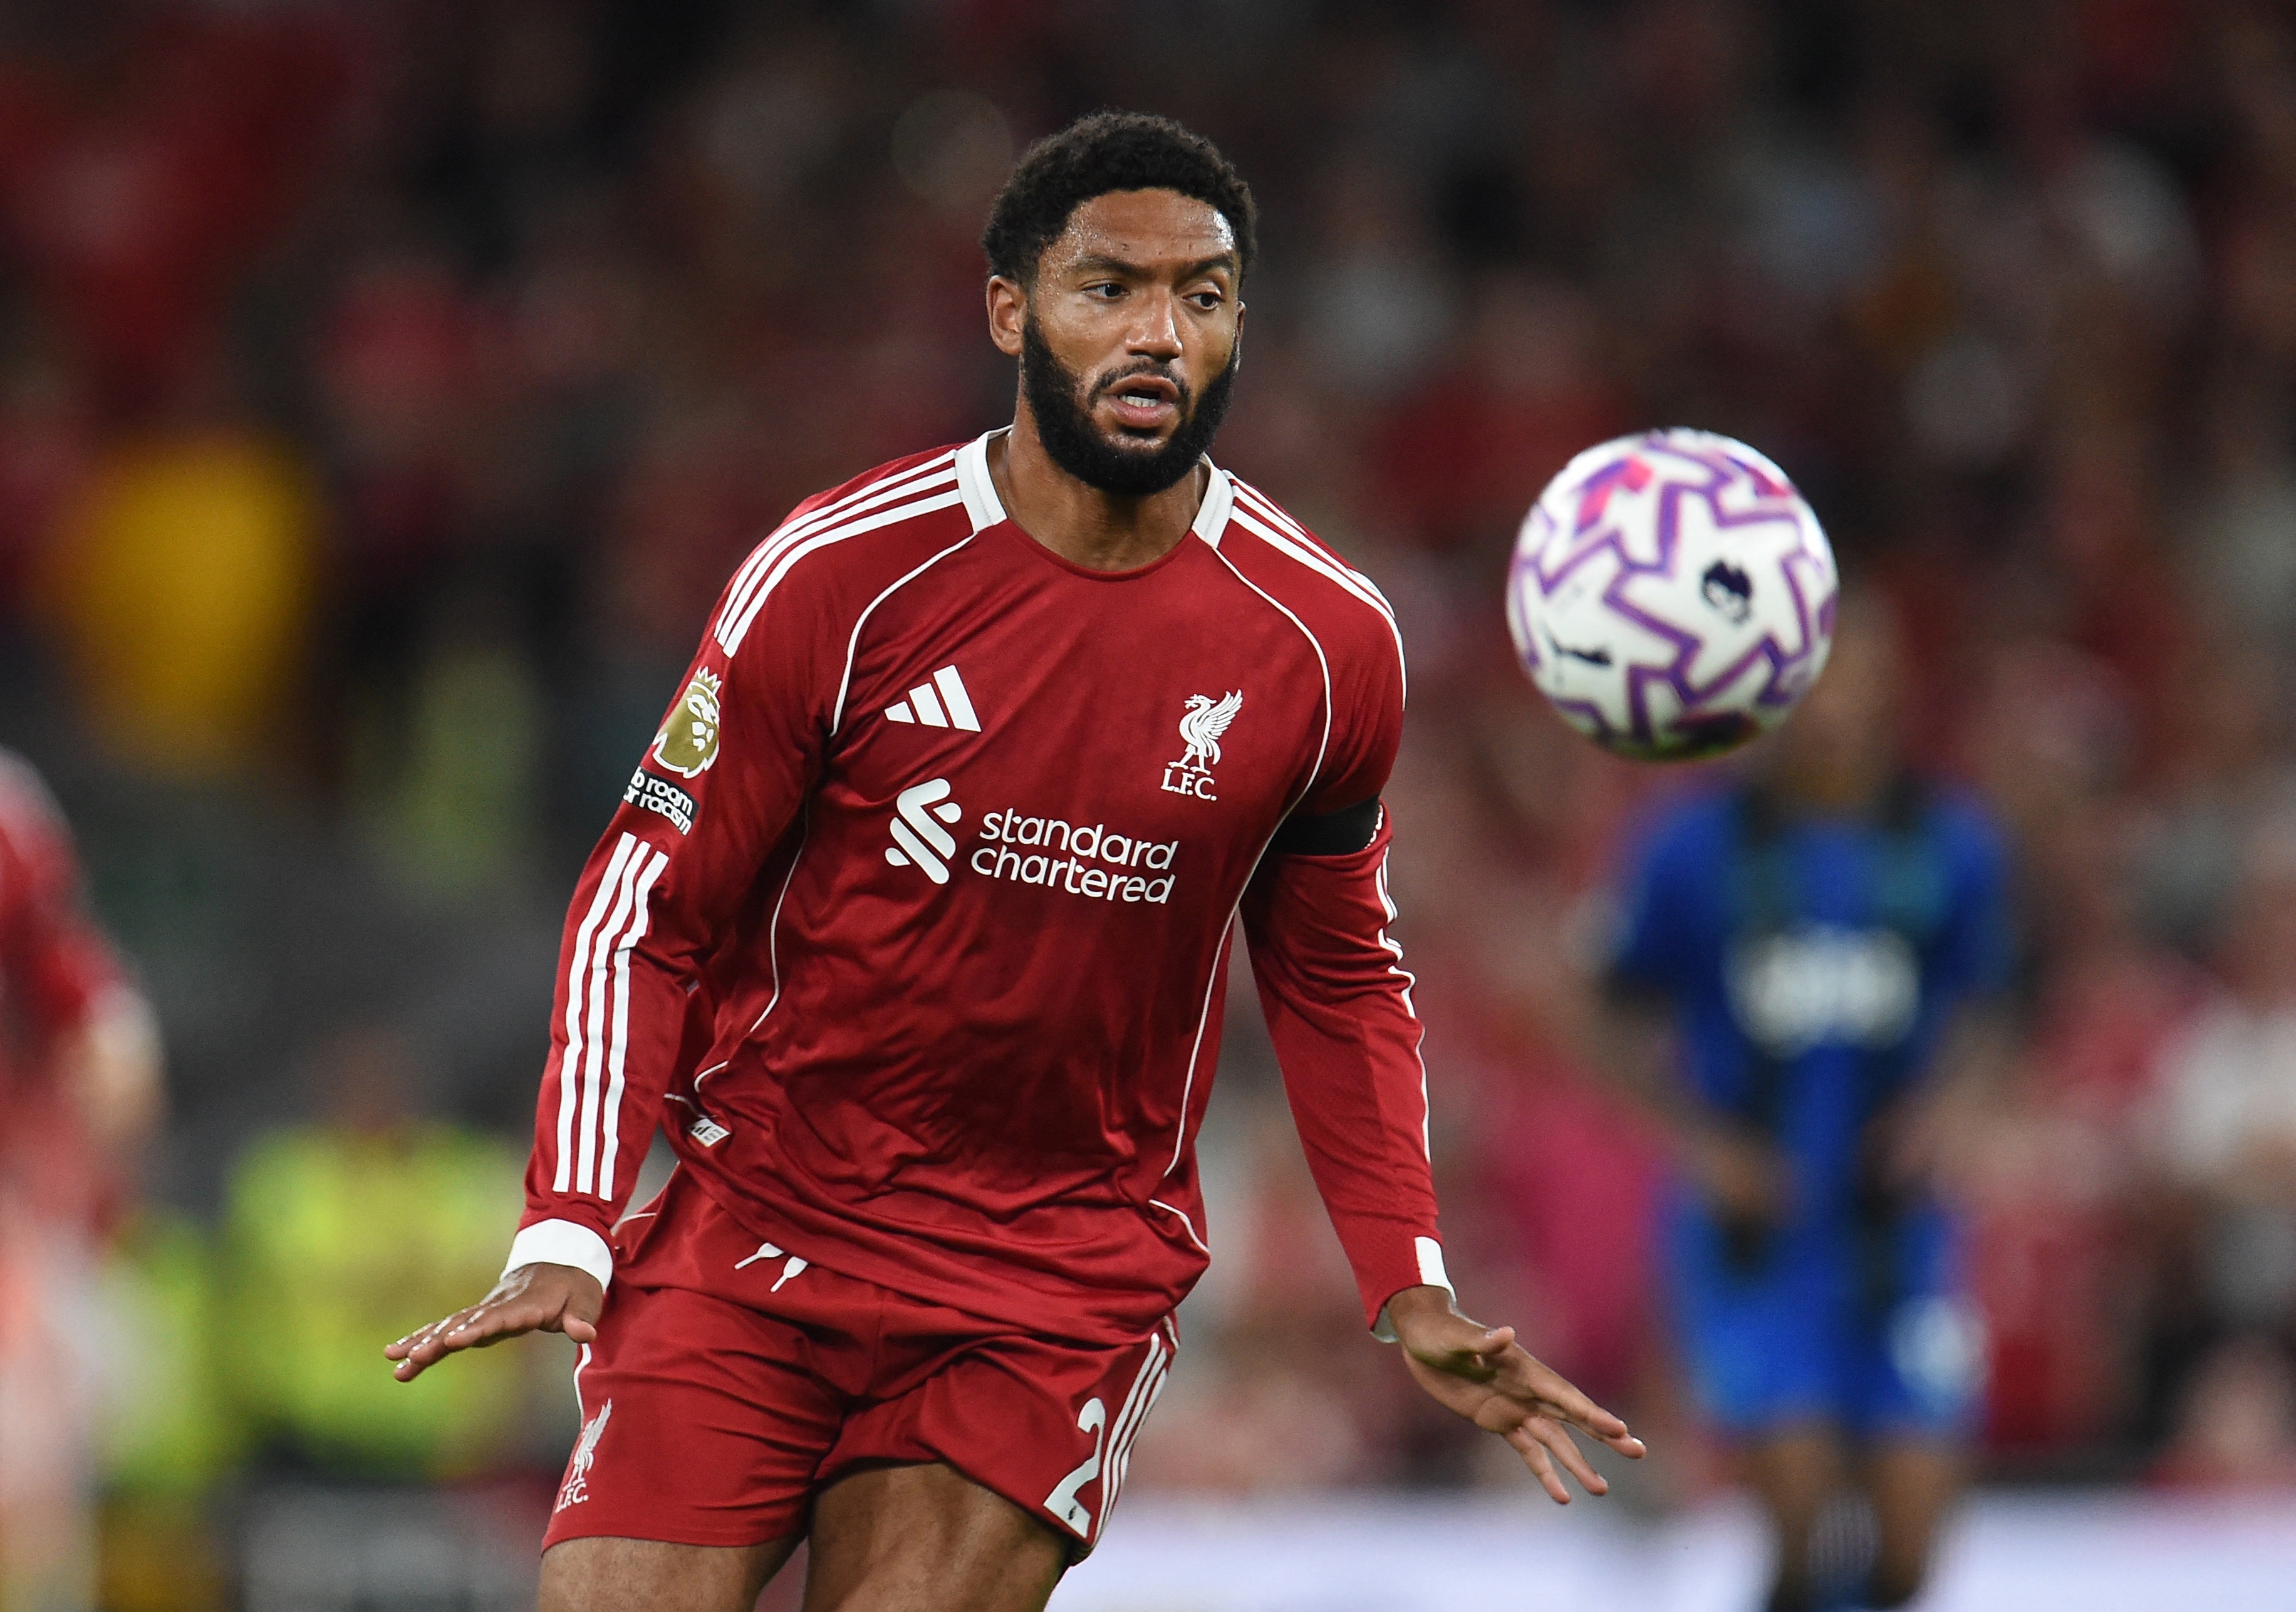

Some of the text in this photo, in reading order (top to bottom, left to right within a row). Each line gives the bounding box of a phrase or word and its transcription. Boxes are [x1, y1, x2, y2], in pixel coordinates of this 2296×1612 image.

[646, 777, 693, 816] room
[1160, 768, 1217, 801] L.F.C.
[979, 808, 1178, 870] standard
[971, 845, 1176, 904] chartered
[1043, 1398, 1106, 1539] 2
